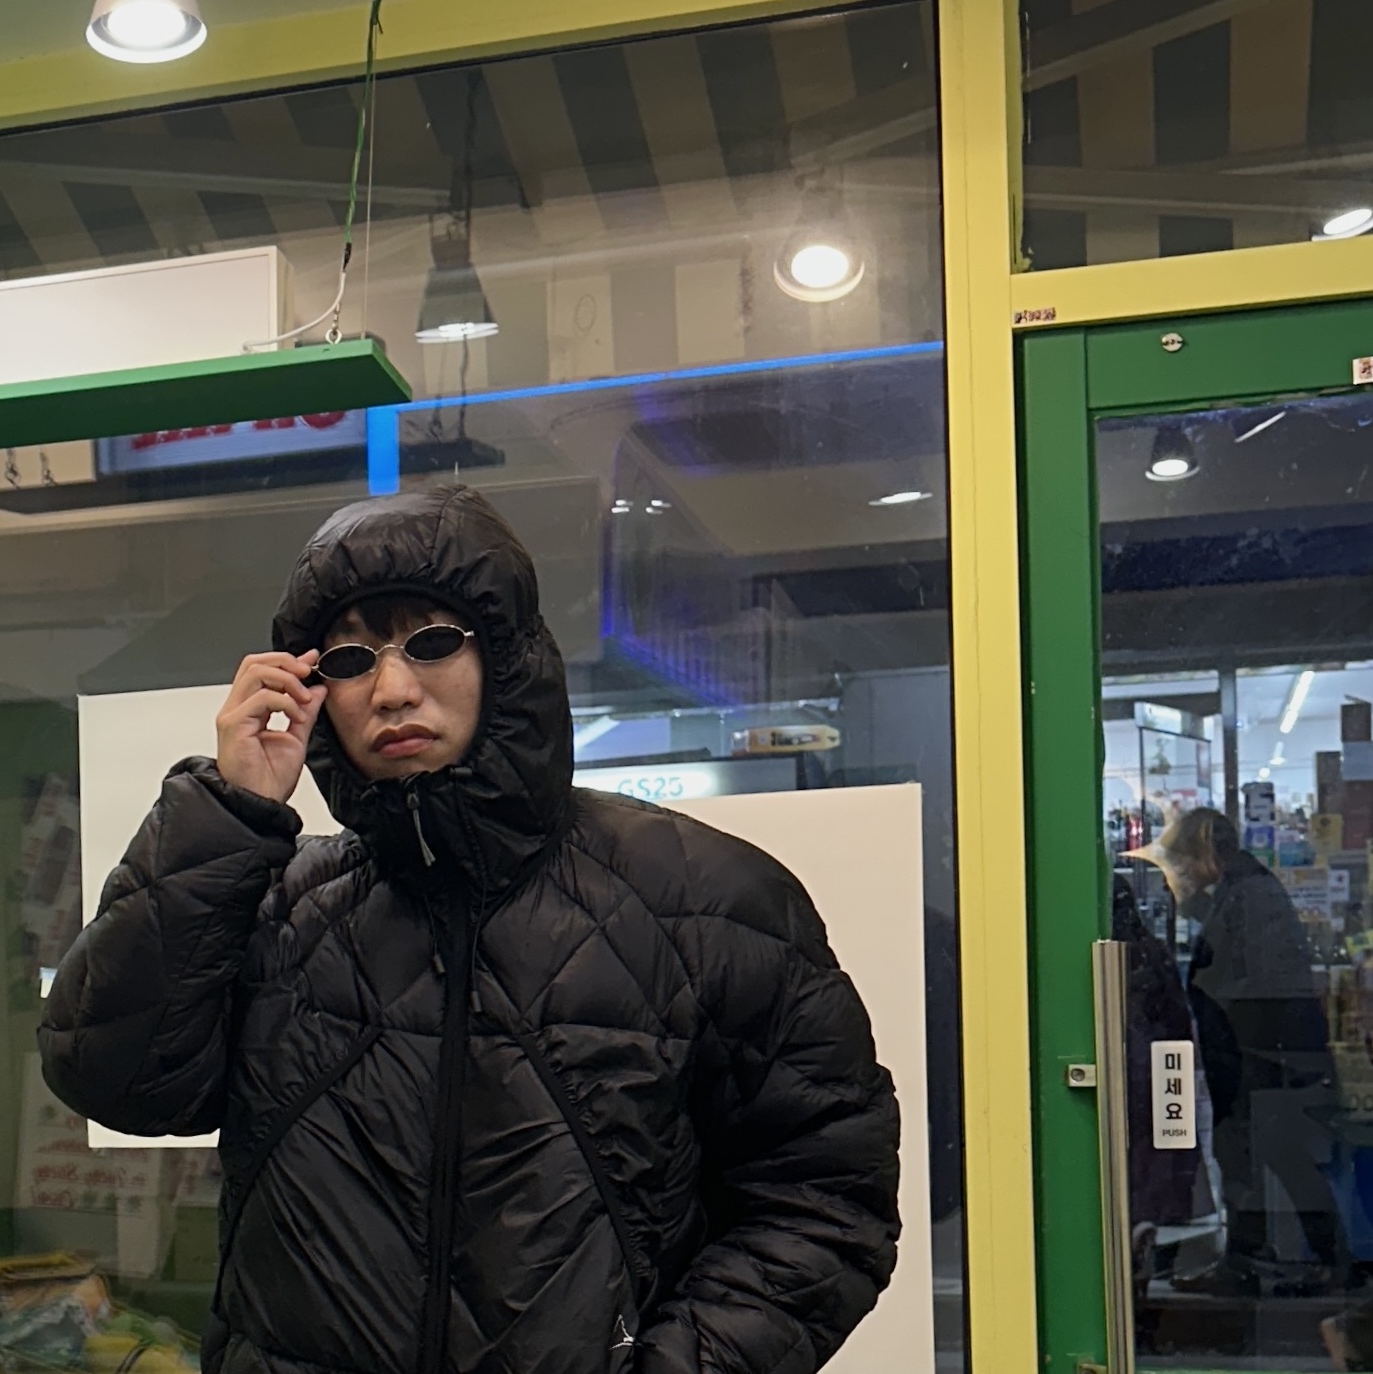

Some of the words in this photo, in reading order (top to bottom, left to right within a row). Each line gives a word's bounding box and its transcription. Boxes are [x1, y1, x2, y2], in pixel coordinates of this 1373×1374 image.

[617, 776, 683, 799] GS25
[1164, 1053, 1183, 1120] 미세요
[1162, 1128, 1187, 1137] PUSH
